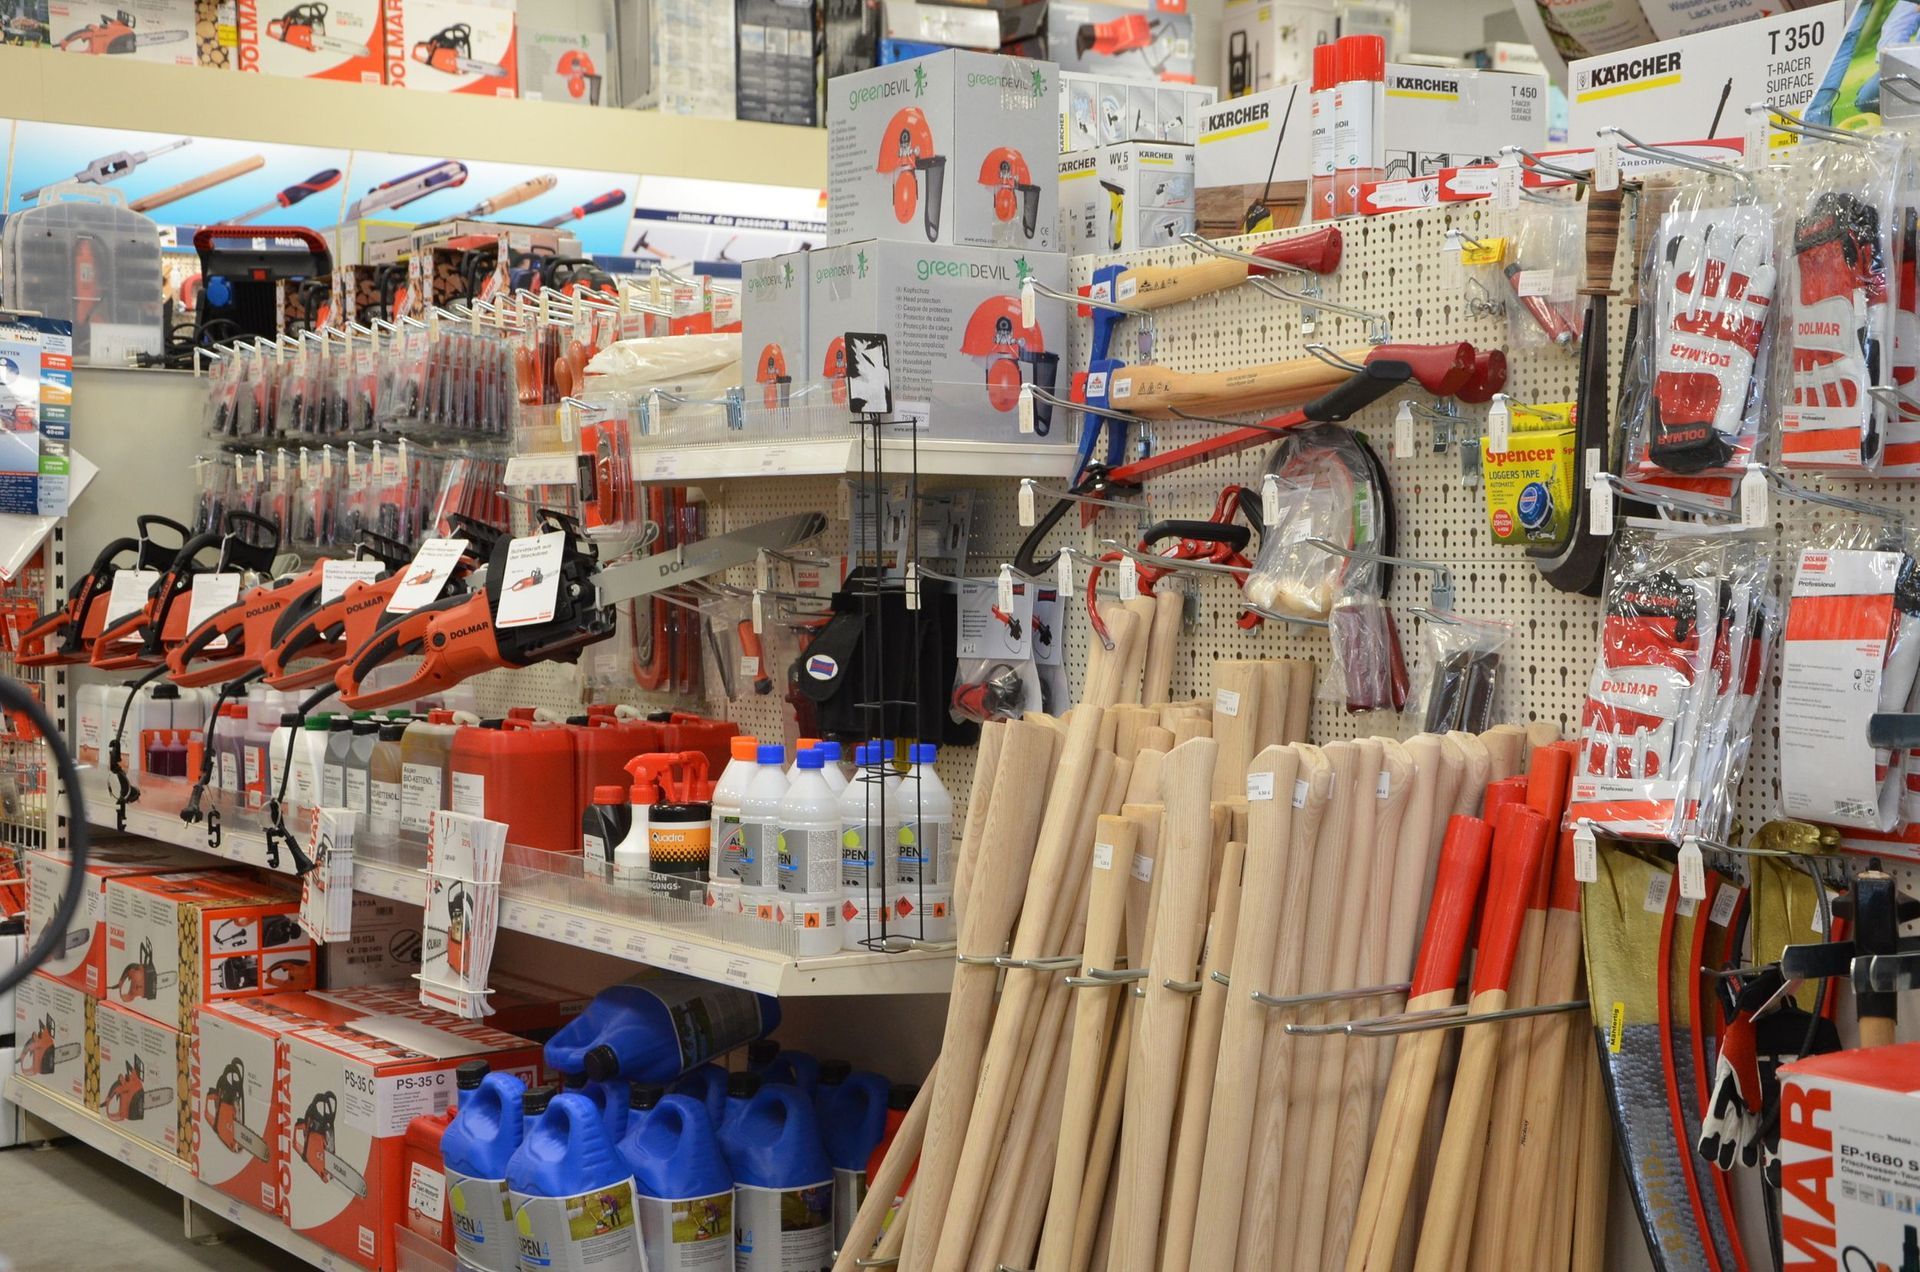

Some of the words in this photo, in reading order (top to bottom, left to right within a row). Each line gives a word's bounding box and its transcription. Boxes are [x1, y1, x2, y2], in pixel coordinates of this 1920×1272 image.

[1768, 31, 1781, 55] T
[1785, 21, 1825, 49] 350
[1591, 52, 1682, 88] KÄRCHER
[1767, 57, 1811, 75] T-RACER
[967, 72, 1028, 91] greenDEVIL
[1396, 76, 1459, 93] KÄRCHER
[1766, 73, 1814, 93] SURFACE
[849, 78, 910, 111] greenDEVIL
[1519, 87, 1538, 99] 450
[1766, 90, 1813, 108] CLEANER
[1209, 102, 1269, 131] KÄRCHER
[1511, 107, 1532, 115] SURFACE
[1511, 114, 1532, 122] CLEANER
[1109, 152, 1122, 165] WV
[1123, 152, 1129, 163] 5
[1139, 150, 1174, 160] KÄRCHER
[816, 264, 856, 284] greenDEVIL
[917, 259, 1011, 281] greenDEVIL
[748, 273, 784, 292] greenDEVIL
[1798, 323, 1840, 337] DOLMAR
[1669, 343, 1731, 368] DOLMAR
[1657, 428, 1708, 445] DOLMAR
[1486, 447, 1556, 467] Spencer
[1489, 471, 1520, 480] LOGGERS
[1522, 469, 1540, 479] TAPE
[1798, 580, 1836, 588] Professional
[246, 602, 282, 618] DOLMAR
[346, 595, 384, 615] DOLMAR
[450, 621, 490, 640] DOLMAR
[1601, 679, 1658, 697] DOLMAR
[652, 832, 684, 843] Quadra
[109, 926, 126, 939] DOLMAR
[1610, 1007, 1620, 1048] Mähfertig
[344, 1070, 367, 1093] PS-35
[368, 1082, 375, 1096] C
[396, 1076, 432, 1090] PS-35
[435, 1074, 446, 1085] C
[191, 1007, 202, 1178] DOLMAR
[278, 1041, 292, 1228] DOLMAR
[1841, 1144, 1904, 1168] EP-1680
[1841, 1166, 1866, 1177] Clean
[1866, 1173, 1892, 1184] water
